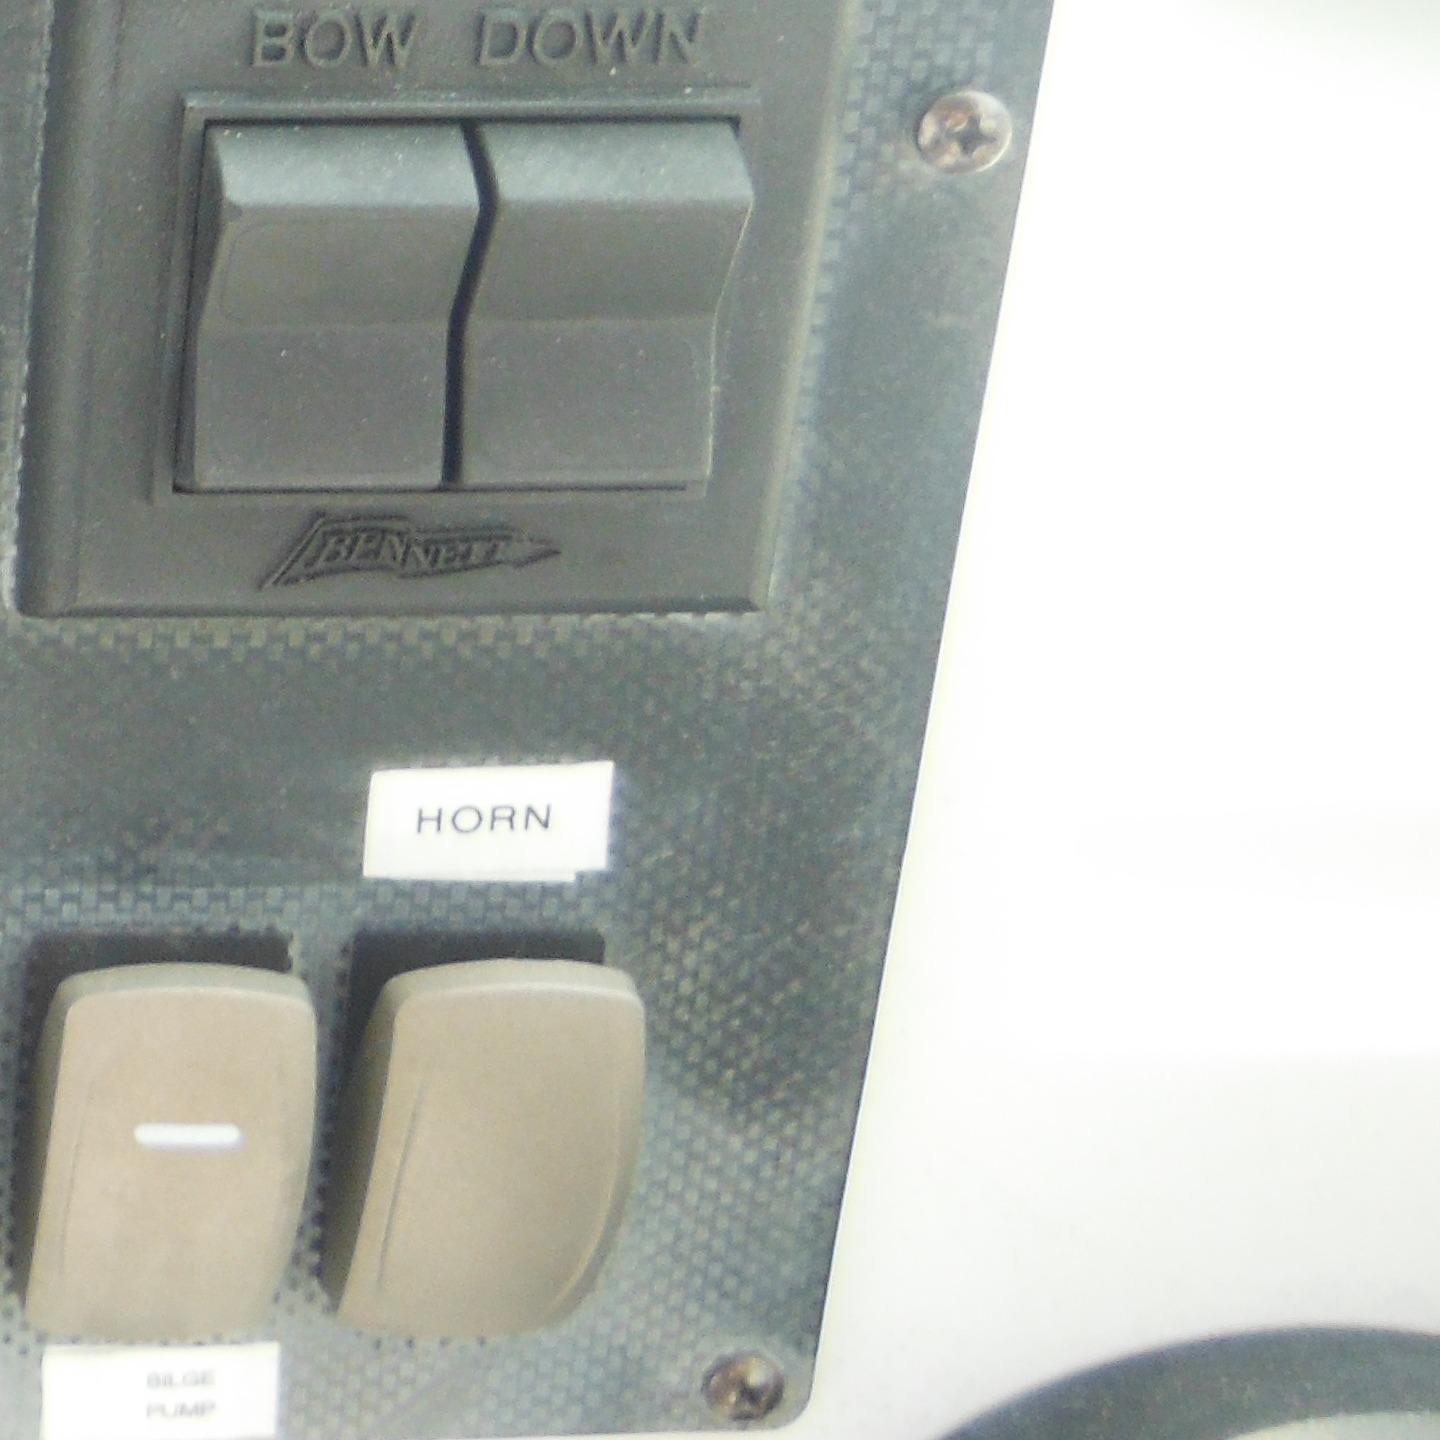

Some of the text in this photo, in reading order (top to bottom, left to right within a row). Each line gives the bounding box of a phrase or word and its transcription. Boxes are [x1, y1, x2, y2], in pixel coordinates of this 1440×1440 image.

[248, 6, 710, 70] BOW DOWN
[416, 804, 553, 835] HORN
[146, 1370, 216, 1390] BILGE
[146, 1399, 217, 1420] PUMP
